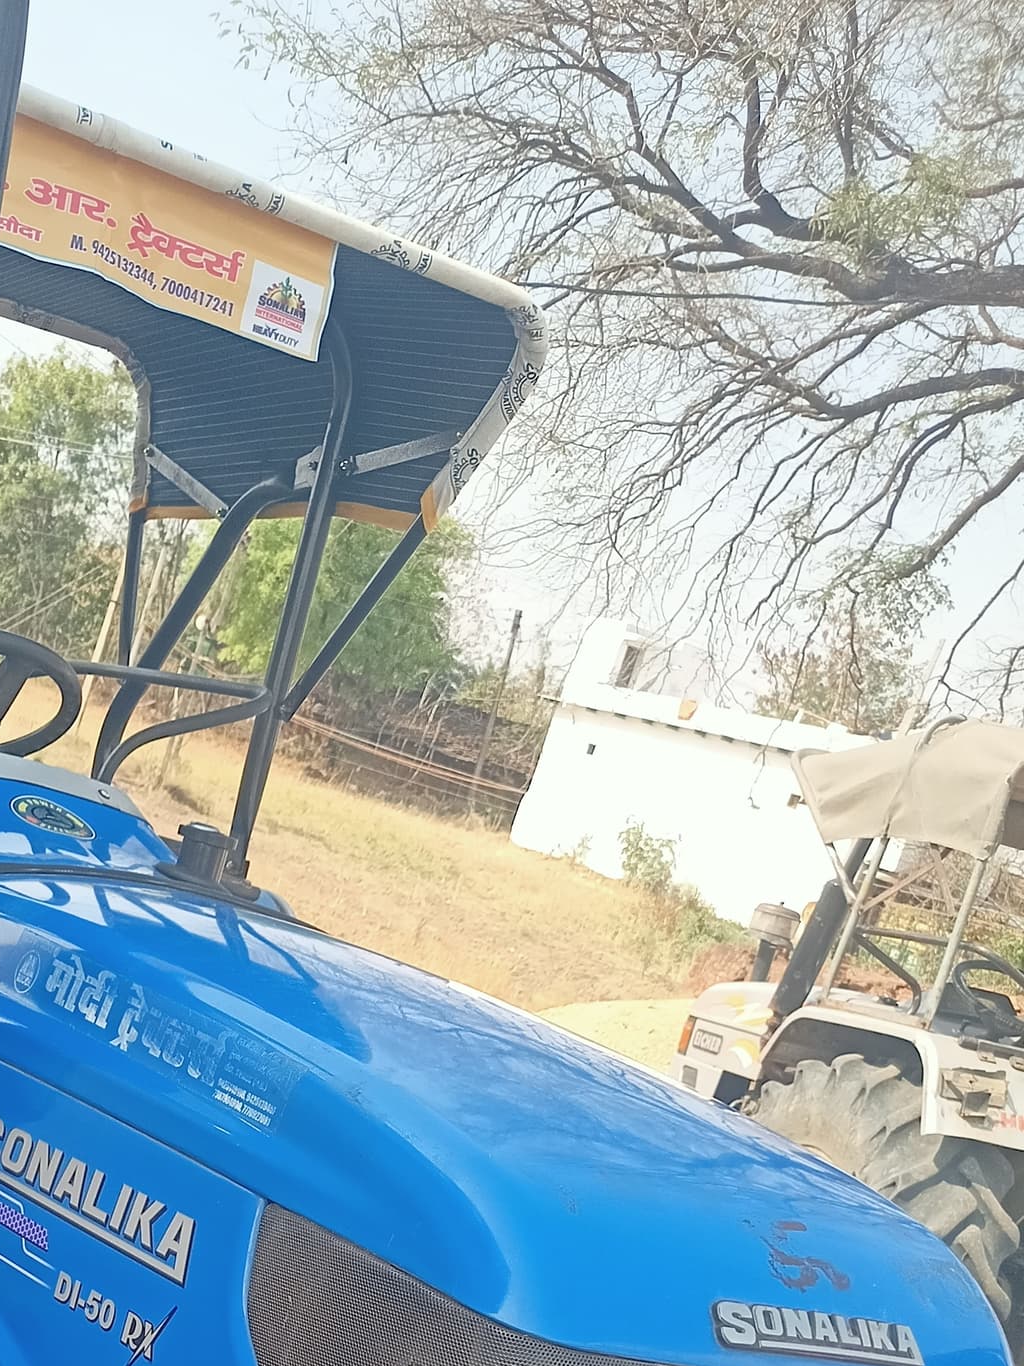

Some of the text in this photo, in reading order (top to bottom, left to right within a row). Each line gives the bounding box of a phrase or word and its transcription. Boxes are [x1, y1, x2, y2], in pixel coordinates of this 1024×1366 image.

[70, 234, 234, 317] M. 9425132344, 7000417241
[255, 306, 304, 332] INTERNATIONAL
[257, 295, 306, 322] SONALIKA
[44, 954, 119, 1029] मोदी
[53, 1269, 117, 1332] DI-50
